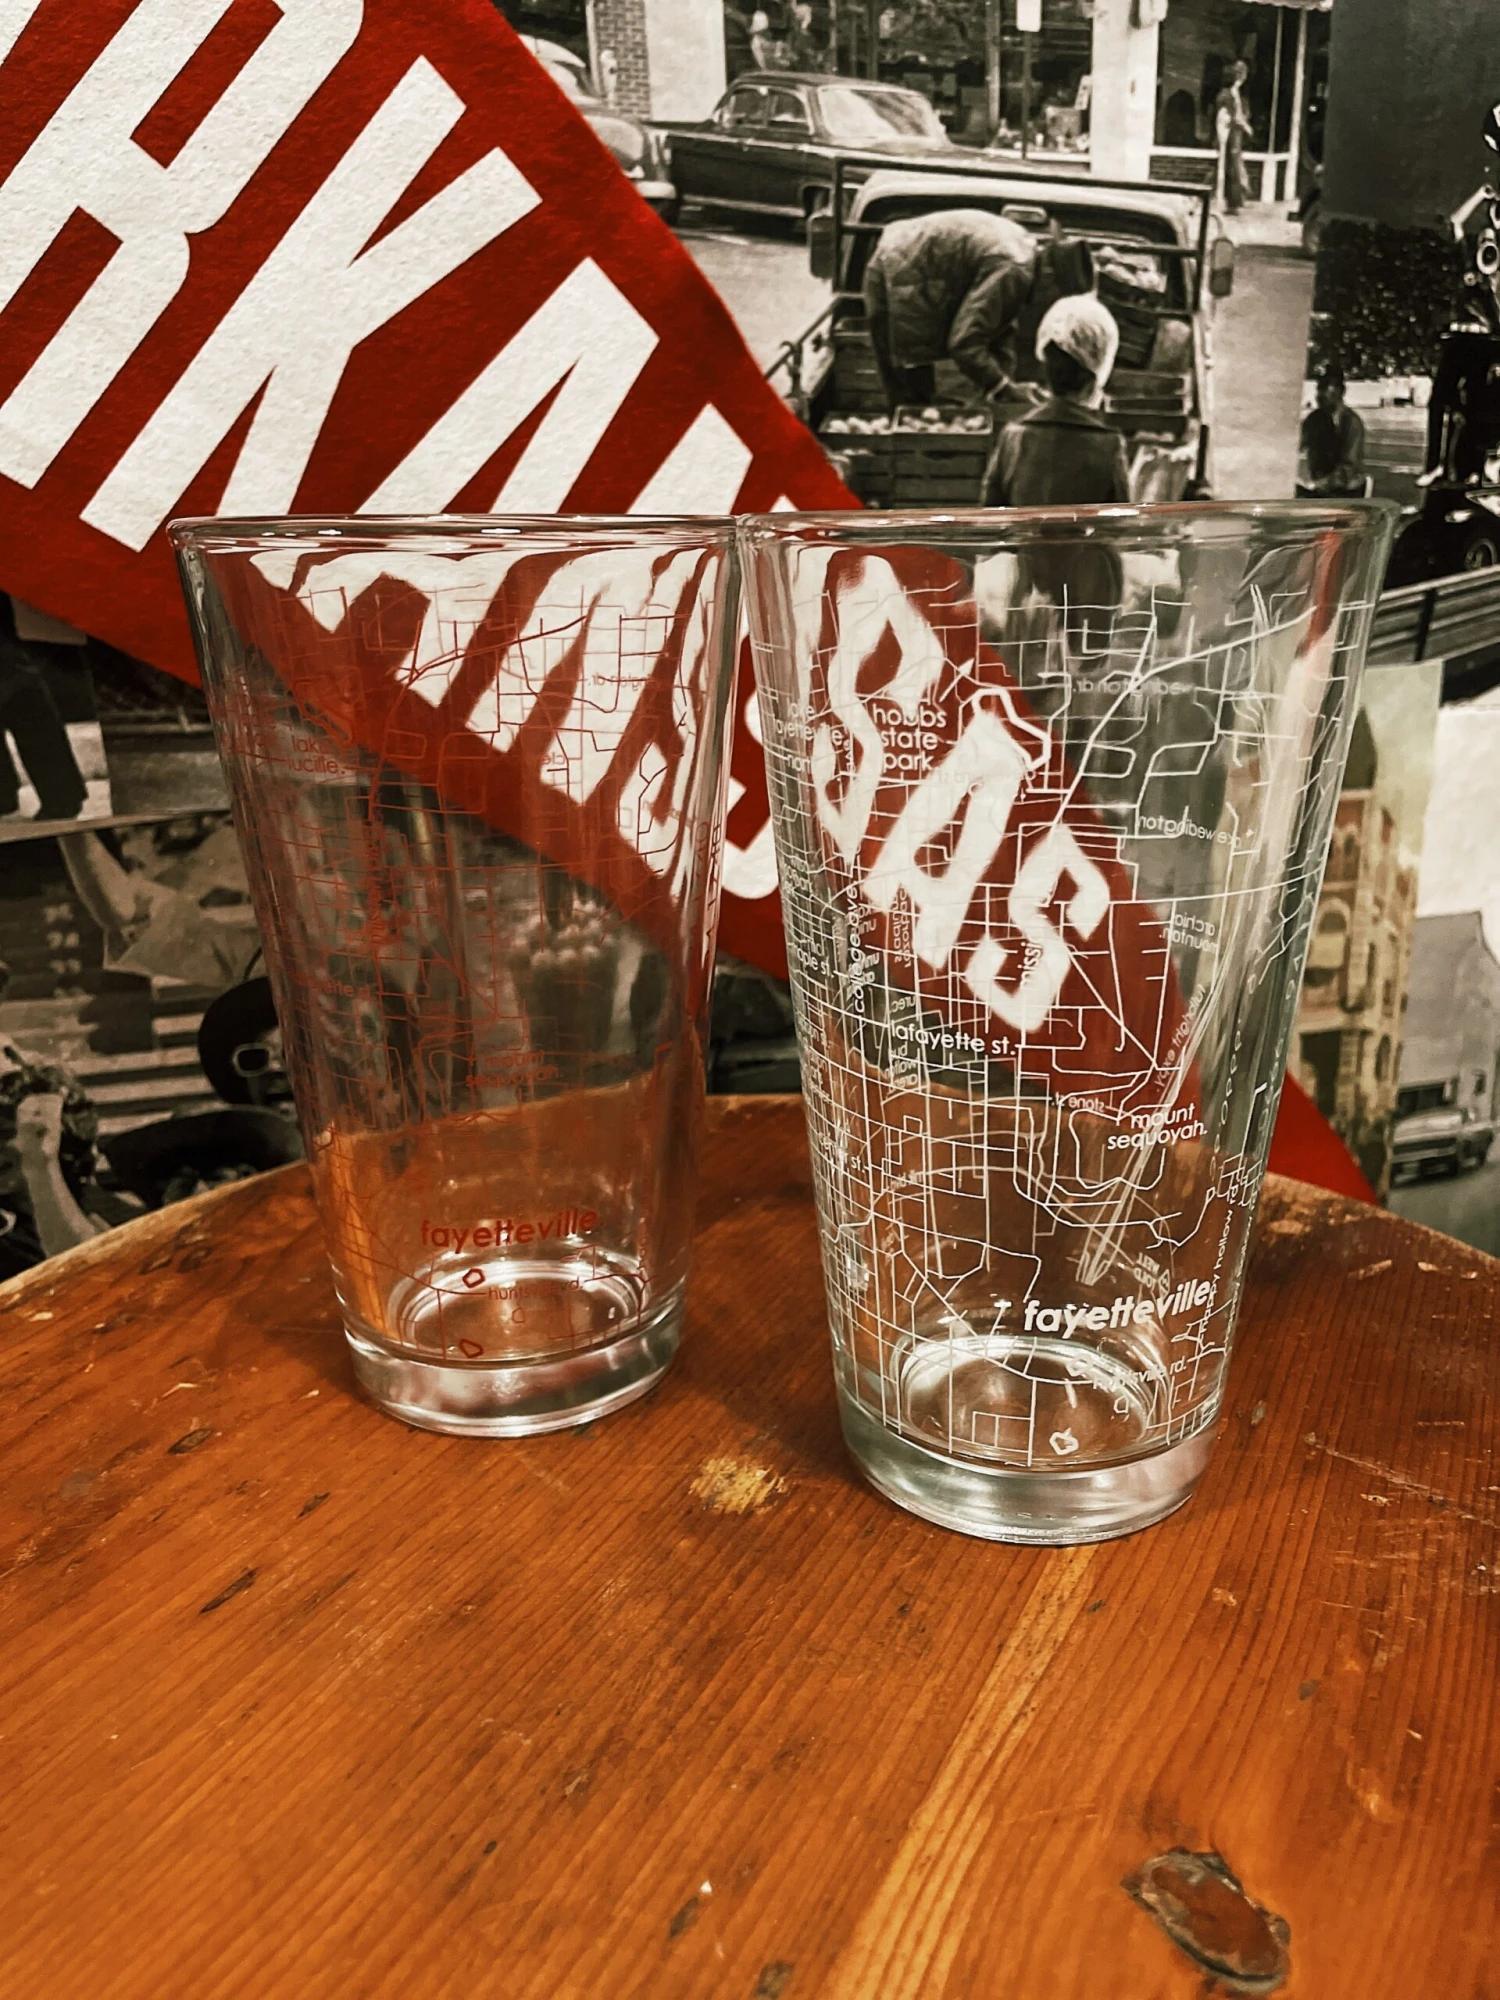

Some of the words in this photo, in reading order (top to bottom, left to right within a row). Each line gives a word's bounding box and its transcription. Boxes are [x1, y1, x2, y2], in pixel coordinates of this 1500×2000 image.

[872, 702, 947, 729] hobbs
[881, 726, 939, 751] state
[883, 750, 935, 777] park
[890, 1019, 986, 1053] lafayette
[991, 1036, 1017, 1056] st.
[484, 1049, 545, 1069] mount
[1131, 1102, 1195, 1129] mount
[1107, 1122, 1208, 1151] sequoyah.
[850, 1155, 866, 1174] st.
[421, 1207, 606, 1255] fayetteville.
[1213, 1207, 1234, 1269] hollow
[1169, 1355, 1188, 1376] rd.
